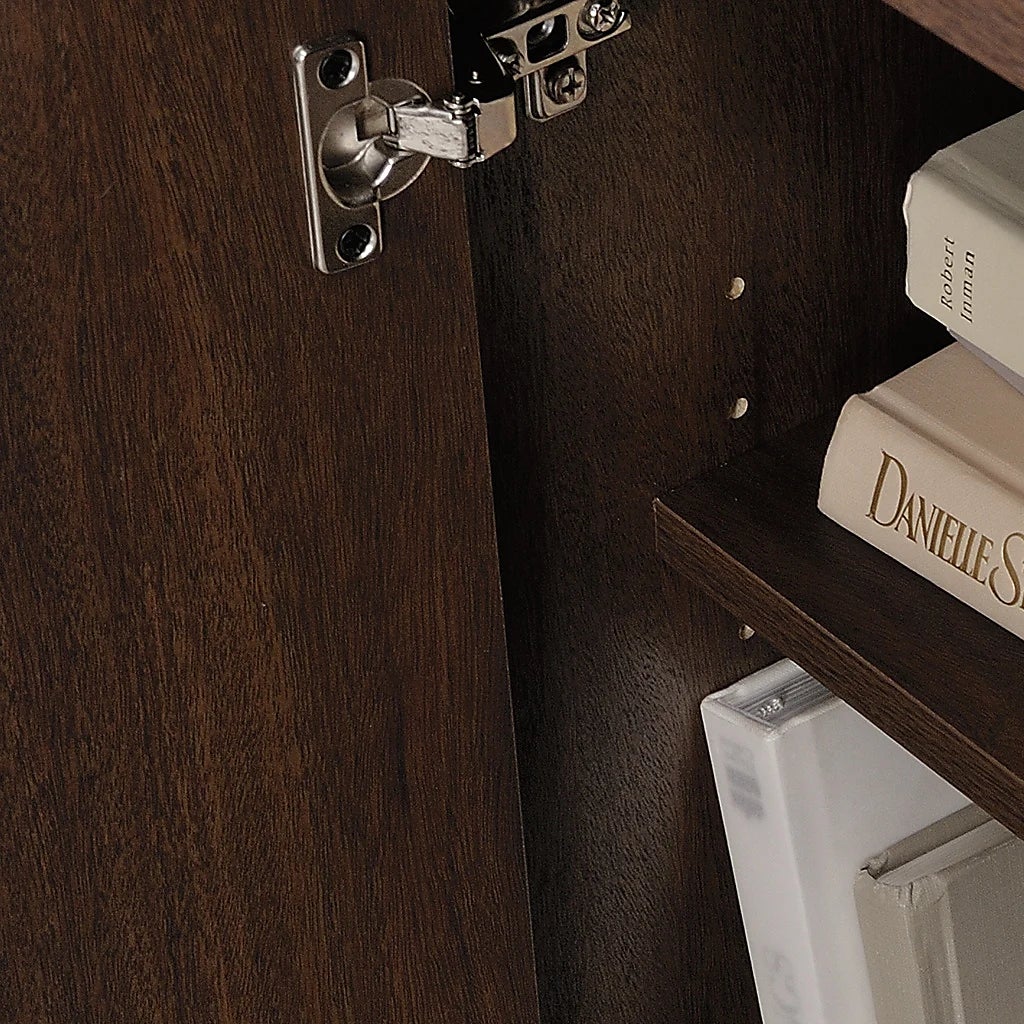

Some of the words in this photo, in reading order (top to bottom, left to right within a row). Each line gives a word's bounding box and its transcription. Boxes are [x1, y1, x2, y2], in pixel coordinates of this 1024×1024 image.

[940, 236, 955, 310] Robert
[960, 251, 976, 323] Inman
[865, 448, 994, 586] DANIELLE
